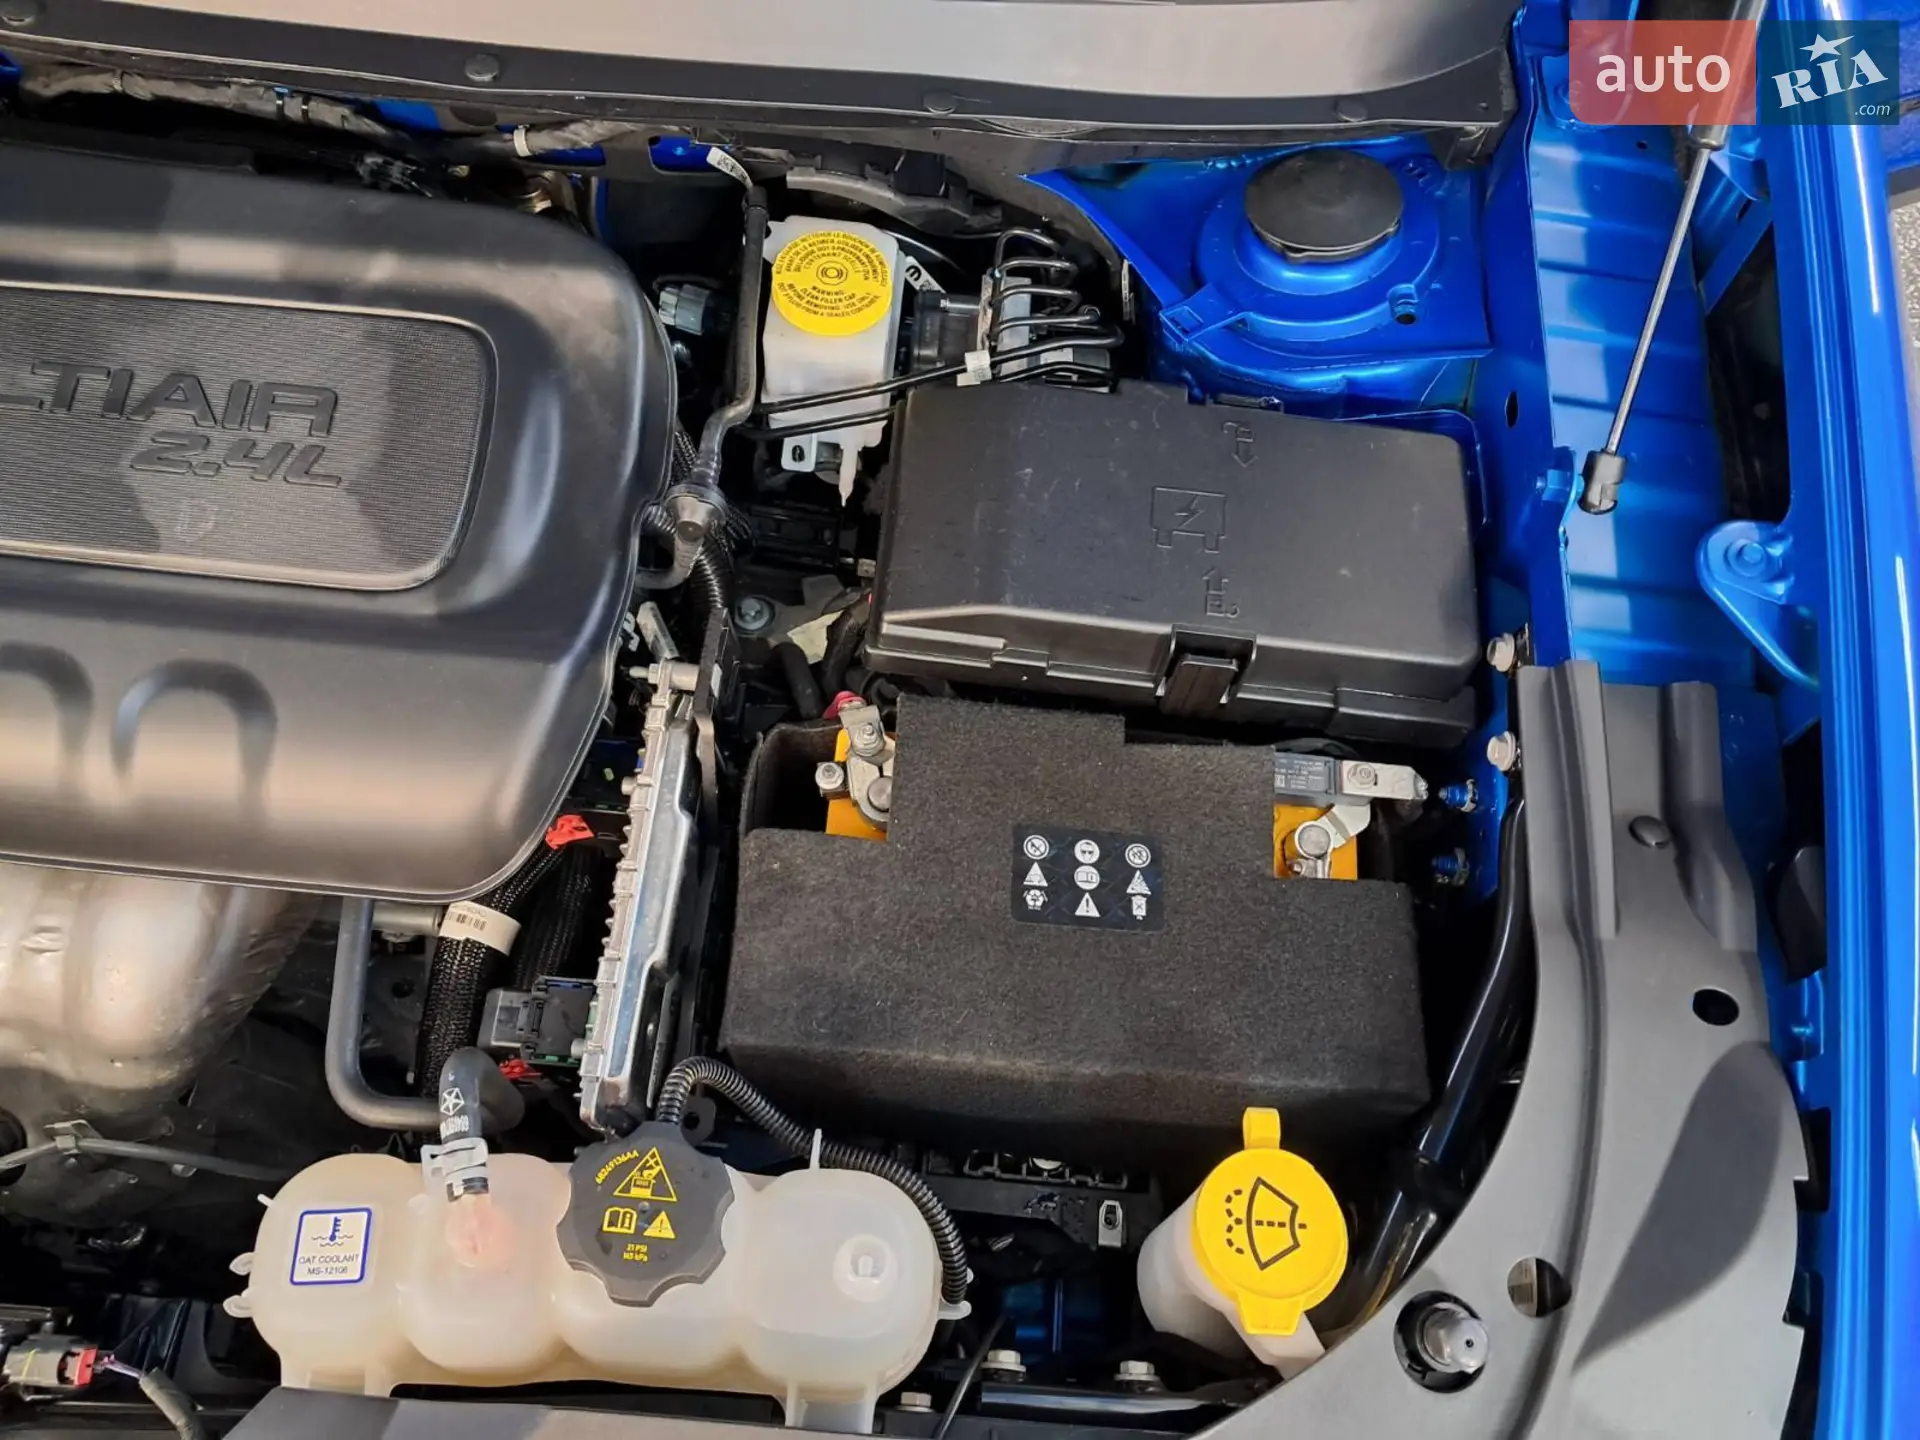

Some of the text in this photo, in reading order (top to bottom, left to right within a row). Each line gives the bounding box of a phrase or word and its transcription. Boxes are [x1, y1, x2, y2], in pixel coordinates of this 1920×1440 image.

[130, 430, 342, 487] 2.4L
[299, 1253, 359, 1265] OAT COOLANT
